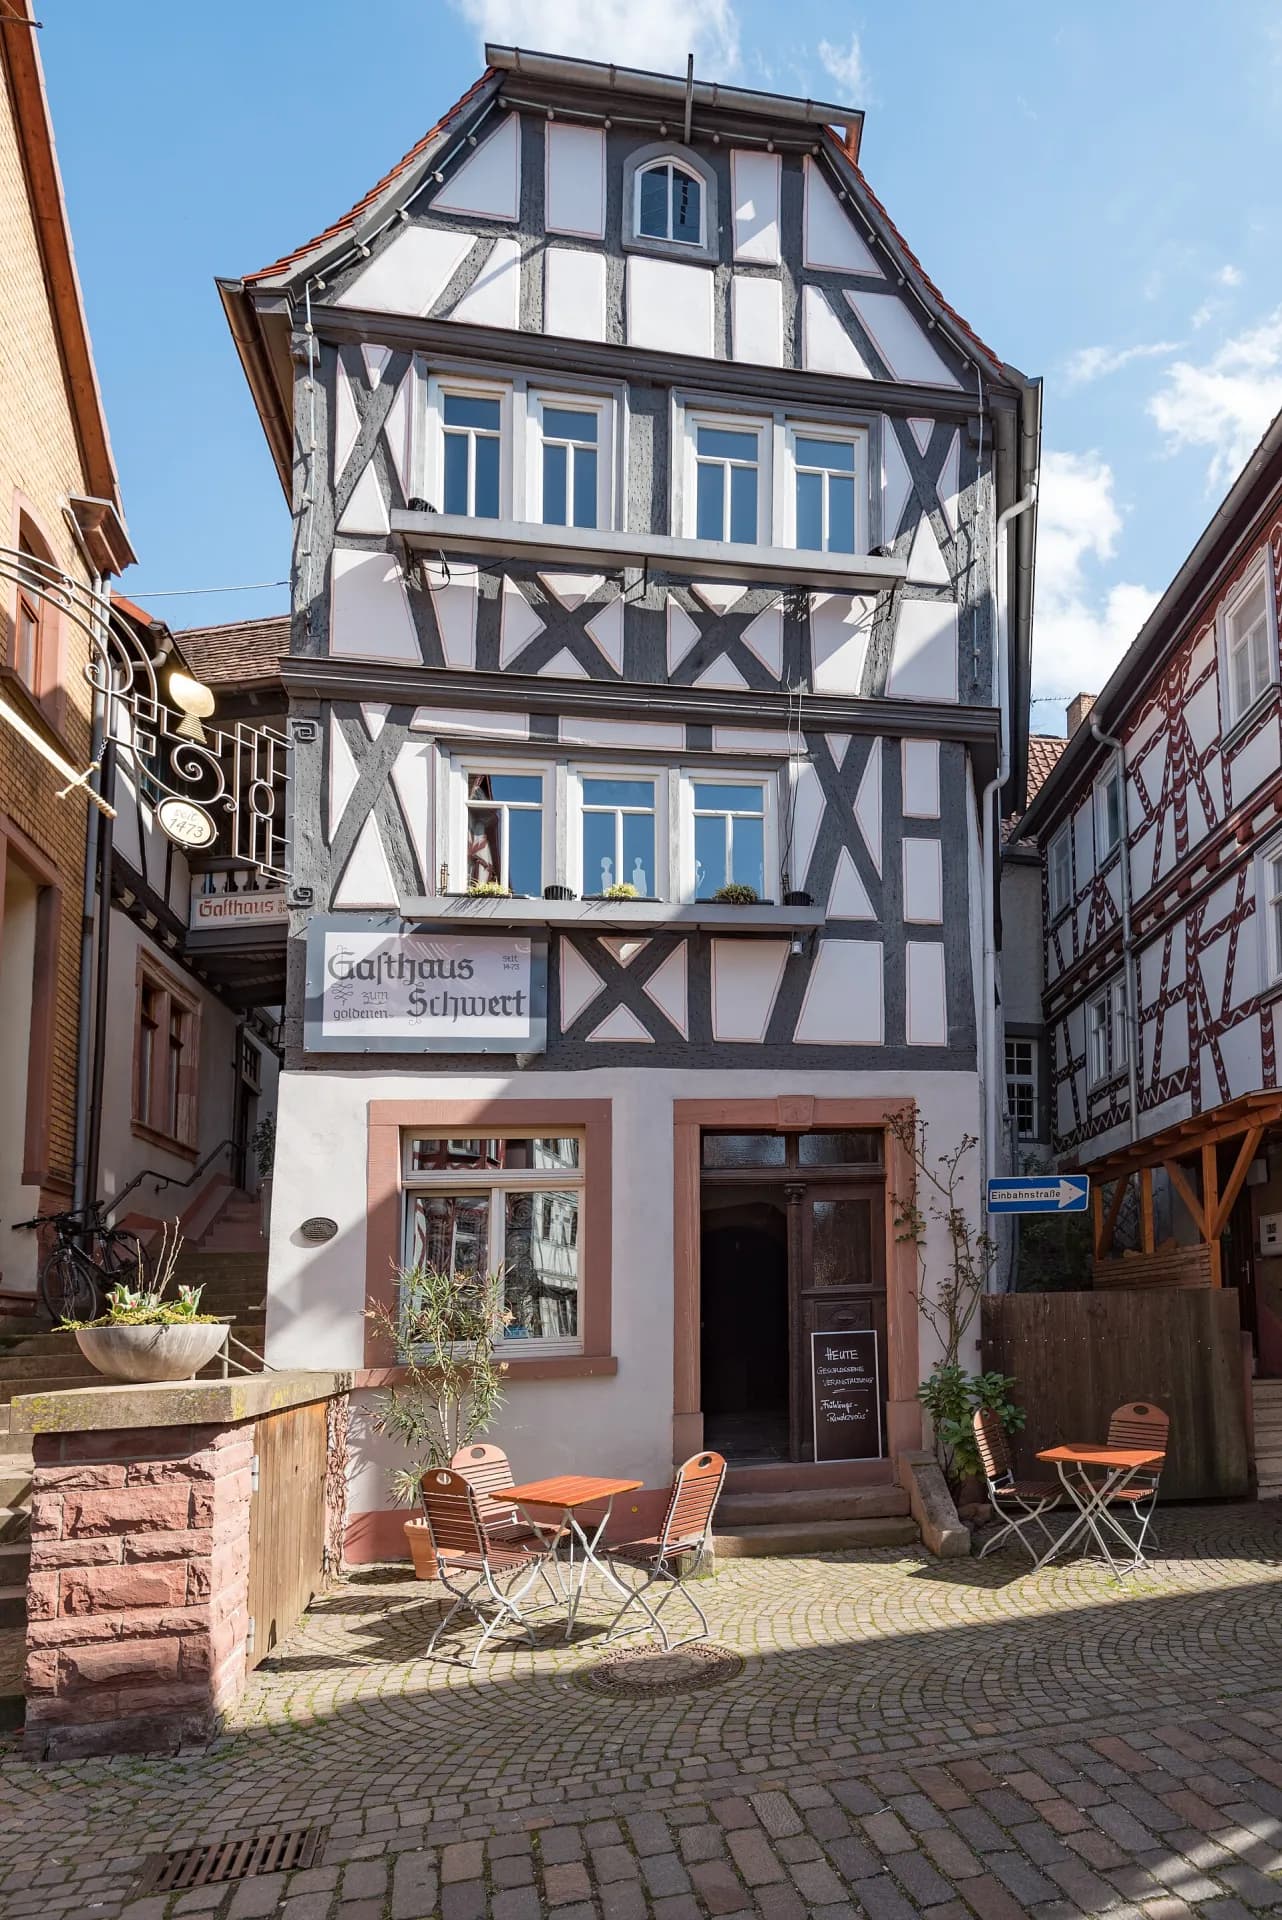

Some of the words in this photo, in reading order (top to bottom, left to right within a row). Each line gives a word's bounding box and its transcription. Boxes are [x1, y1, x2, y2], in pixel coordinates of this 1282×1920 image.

[169, 817, 204, 838] 1473
[360, 990, 389, 1003] zum
[406, 988, 527, 1023] Schwert
[333, 1007, 390, 1021] goldenen
[991, 1189, 1061, 1200] Einbahnstraße
[824, 1346, 859, 1361] HEUTE
